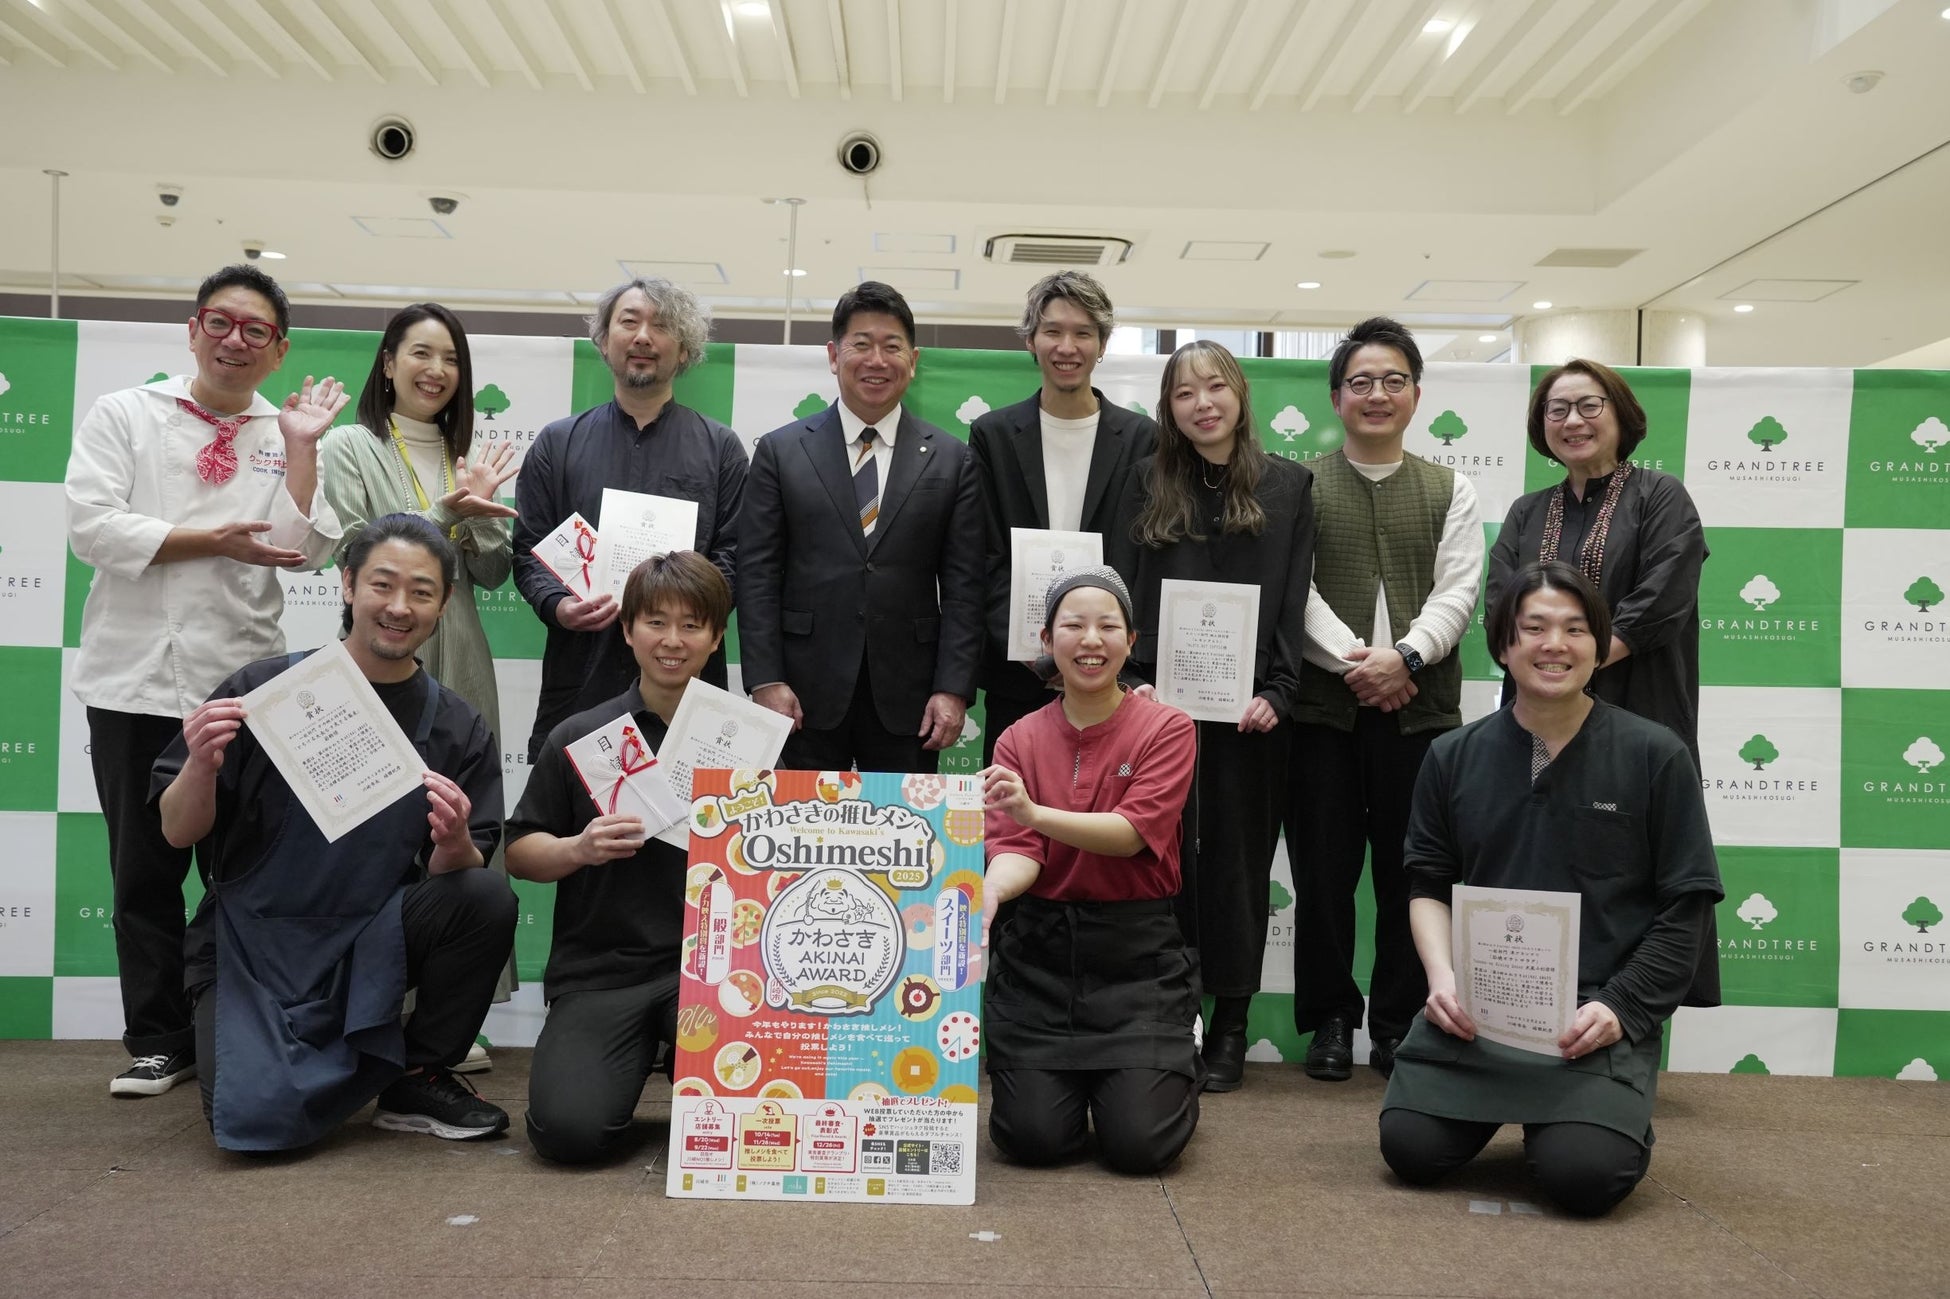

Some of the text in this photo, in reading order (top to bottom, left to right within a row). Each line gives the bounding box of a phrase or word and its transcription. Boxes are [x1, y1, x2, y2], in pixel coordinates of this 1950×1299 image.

[1707, 460, 1824, 472] GRANDTREE
[1701, 619, 1819, 631] GRANDTREE
[1701, 779, 1817, 791] GRANDTREE
[743, 804, 929, 837] かわさきの推しメシへ
[790, 826, 885, 836] Welcome to Kawasaki's
[746, 834, 926, 868] Oshimeshi
[896, 871, 921, 881] 2025
[788, 928, 877, 949] かわさき
[940, 898, 954, 976] スイーツ部門
[798, 951, 865, 966] AKINAI
[795, 967, 867, 982] AWARD
